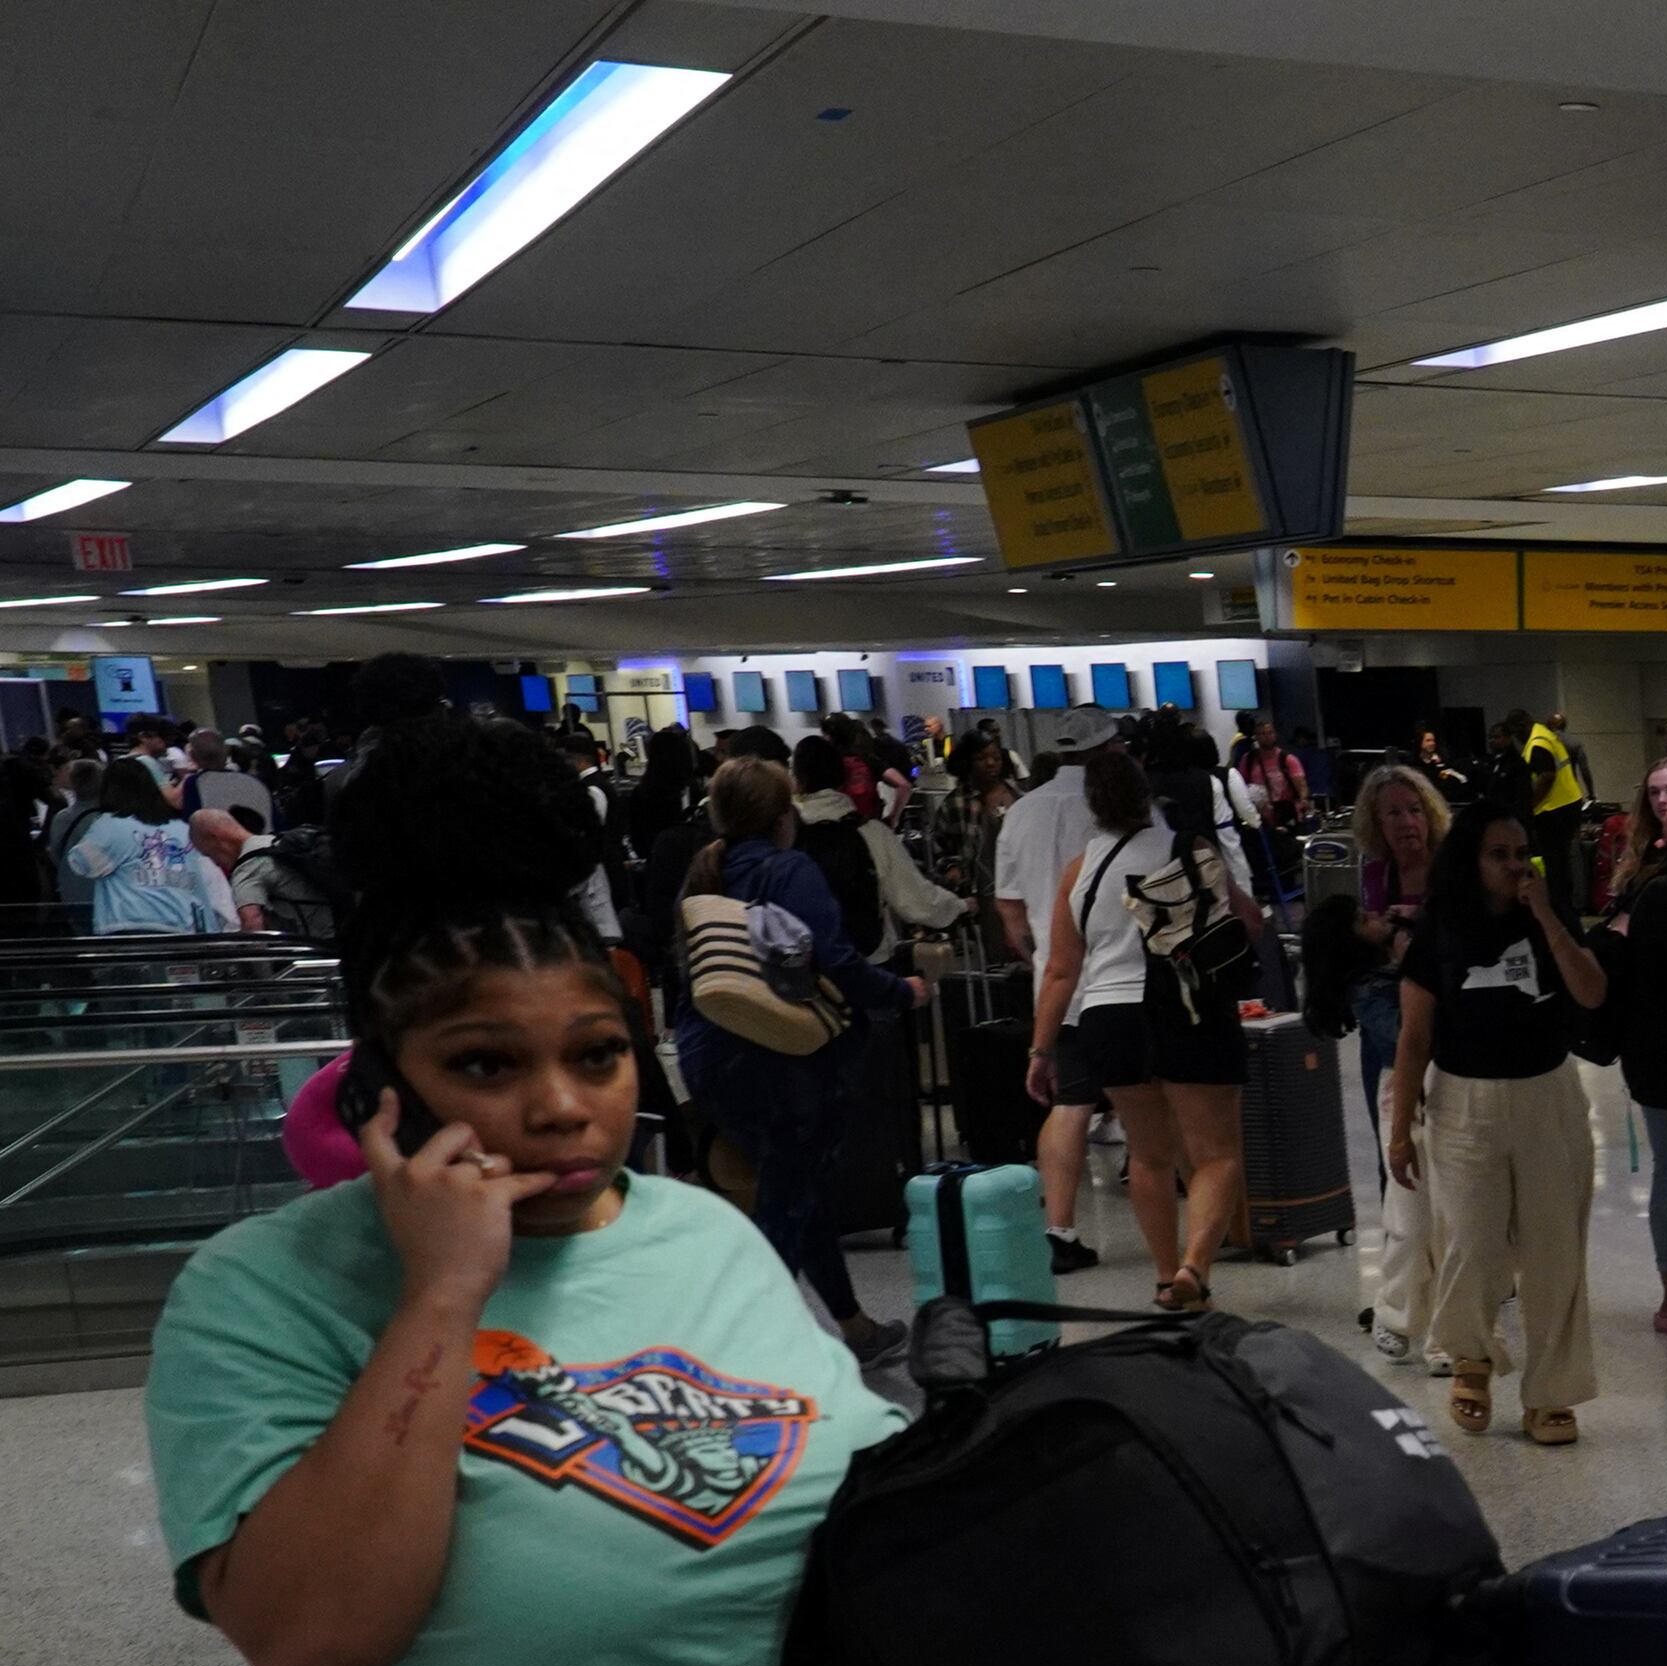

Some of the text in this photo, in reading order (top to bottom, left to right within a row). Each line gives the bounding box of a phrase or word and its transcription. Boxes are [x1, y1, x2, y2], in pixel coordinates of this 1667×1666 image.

[79, 536, 130, 570] EXIT
[1321, 554, 1416, 566] Economy Check-in
[1322, 574, 1457, 587] United Bag Drop Shortcut
[1322, 594, 1341, 604] Pet
[1355, 593, 1385, 605] Cabin
[1387, 593, 1431, 605] Check-in
[1504, 954, 1529, 968] NEW
[1504, 967, 1531, 982] YORK
